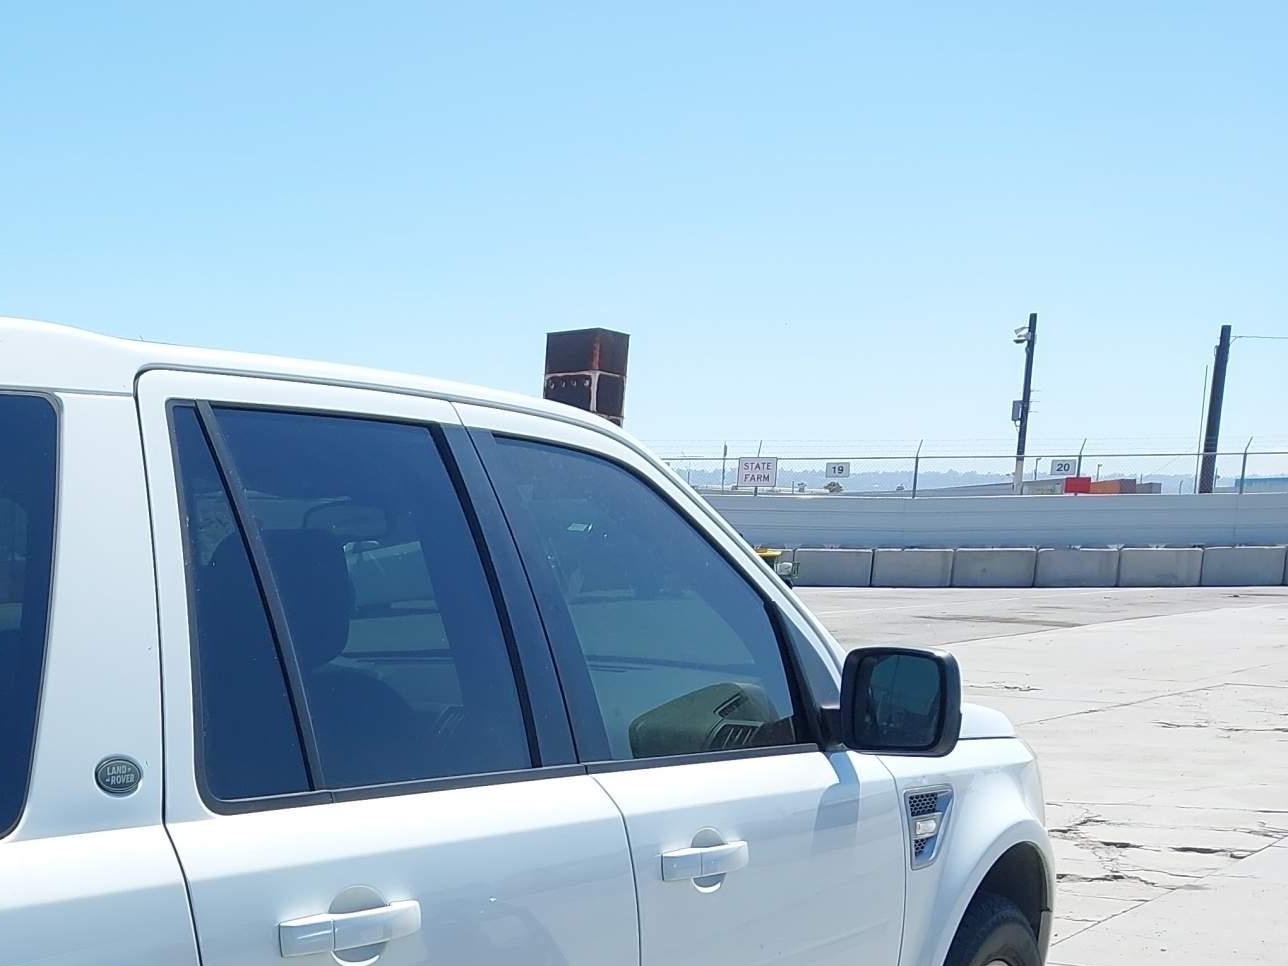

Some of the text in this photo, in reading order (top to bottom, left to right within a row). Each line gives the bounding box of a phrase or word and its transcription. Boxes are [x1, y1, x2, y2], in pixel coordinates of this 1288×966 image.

[744, 462, 772, 471] STATE
[832, 465, 844, 474] 19
[1056, 463, 1070, 472] 20
[744, 473, 770, 482] FARM
[107, 765, 127, 776] LAND
[110, 774, 135, 785] ROVER
